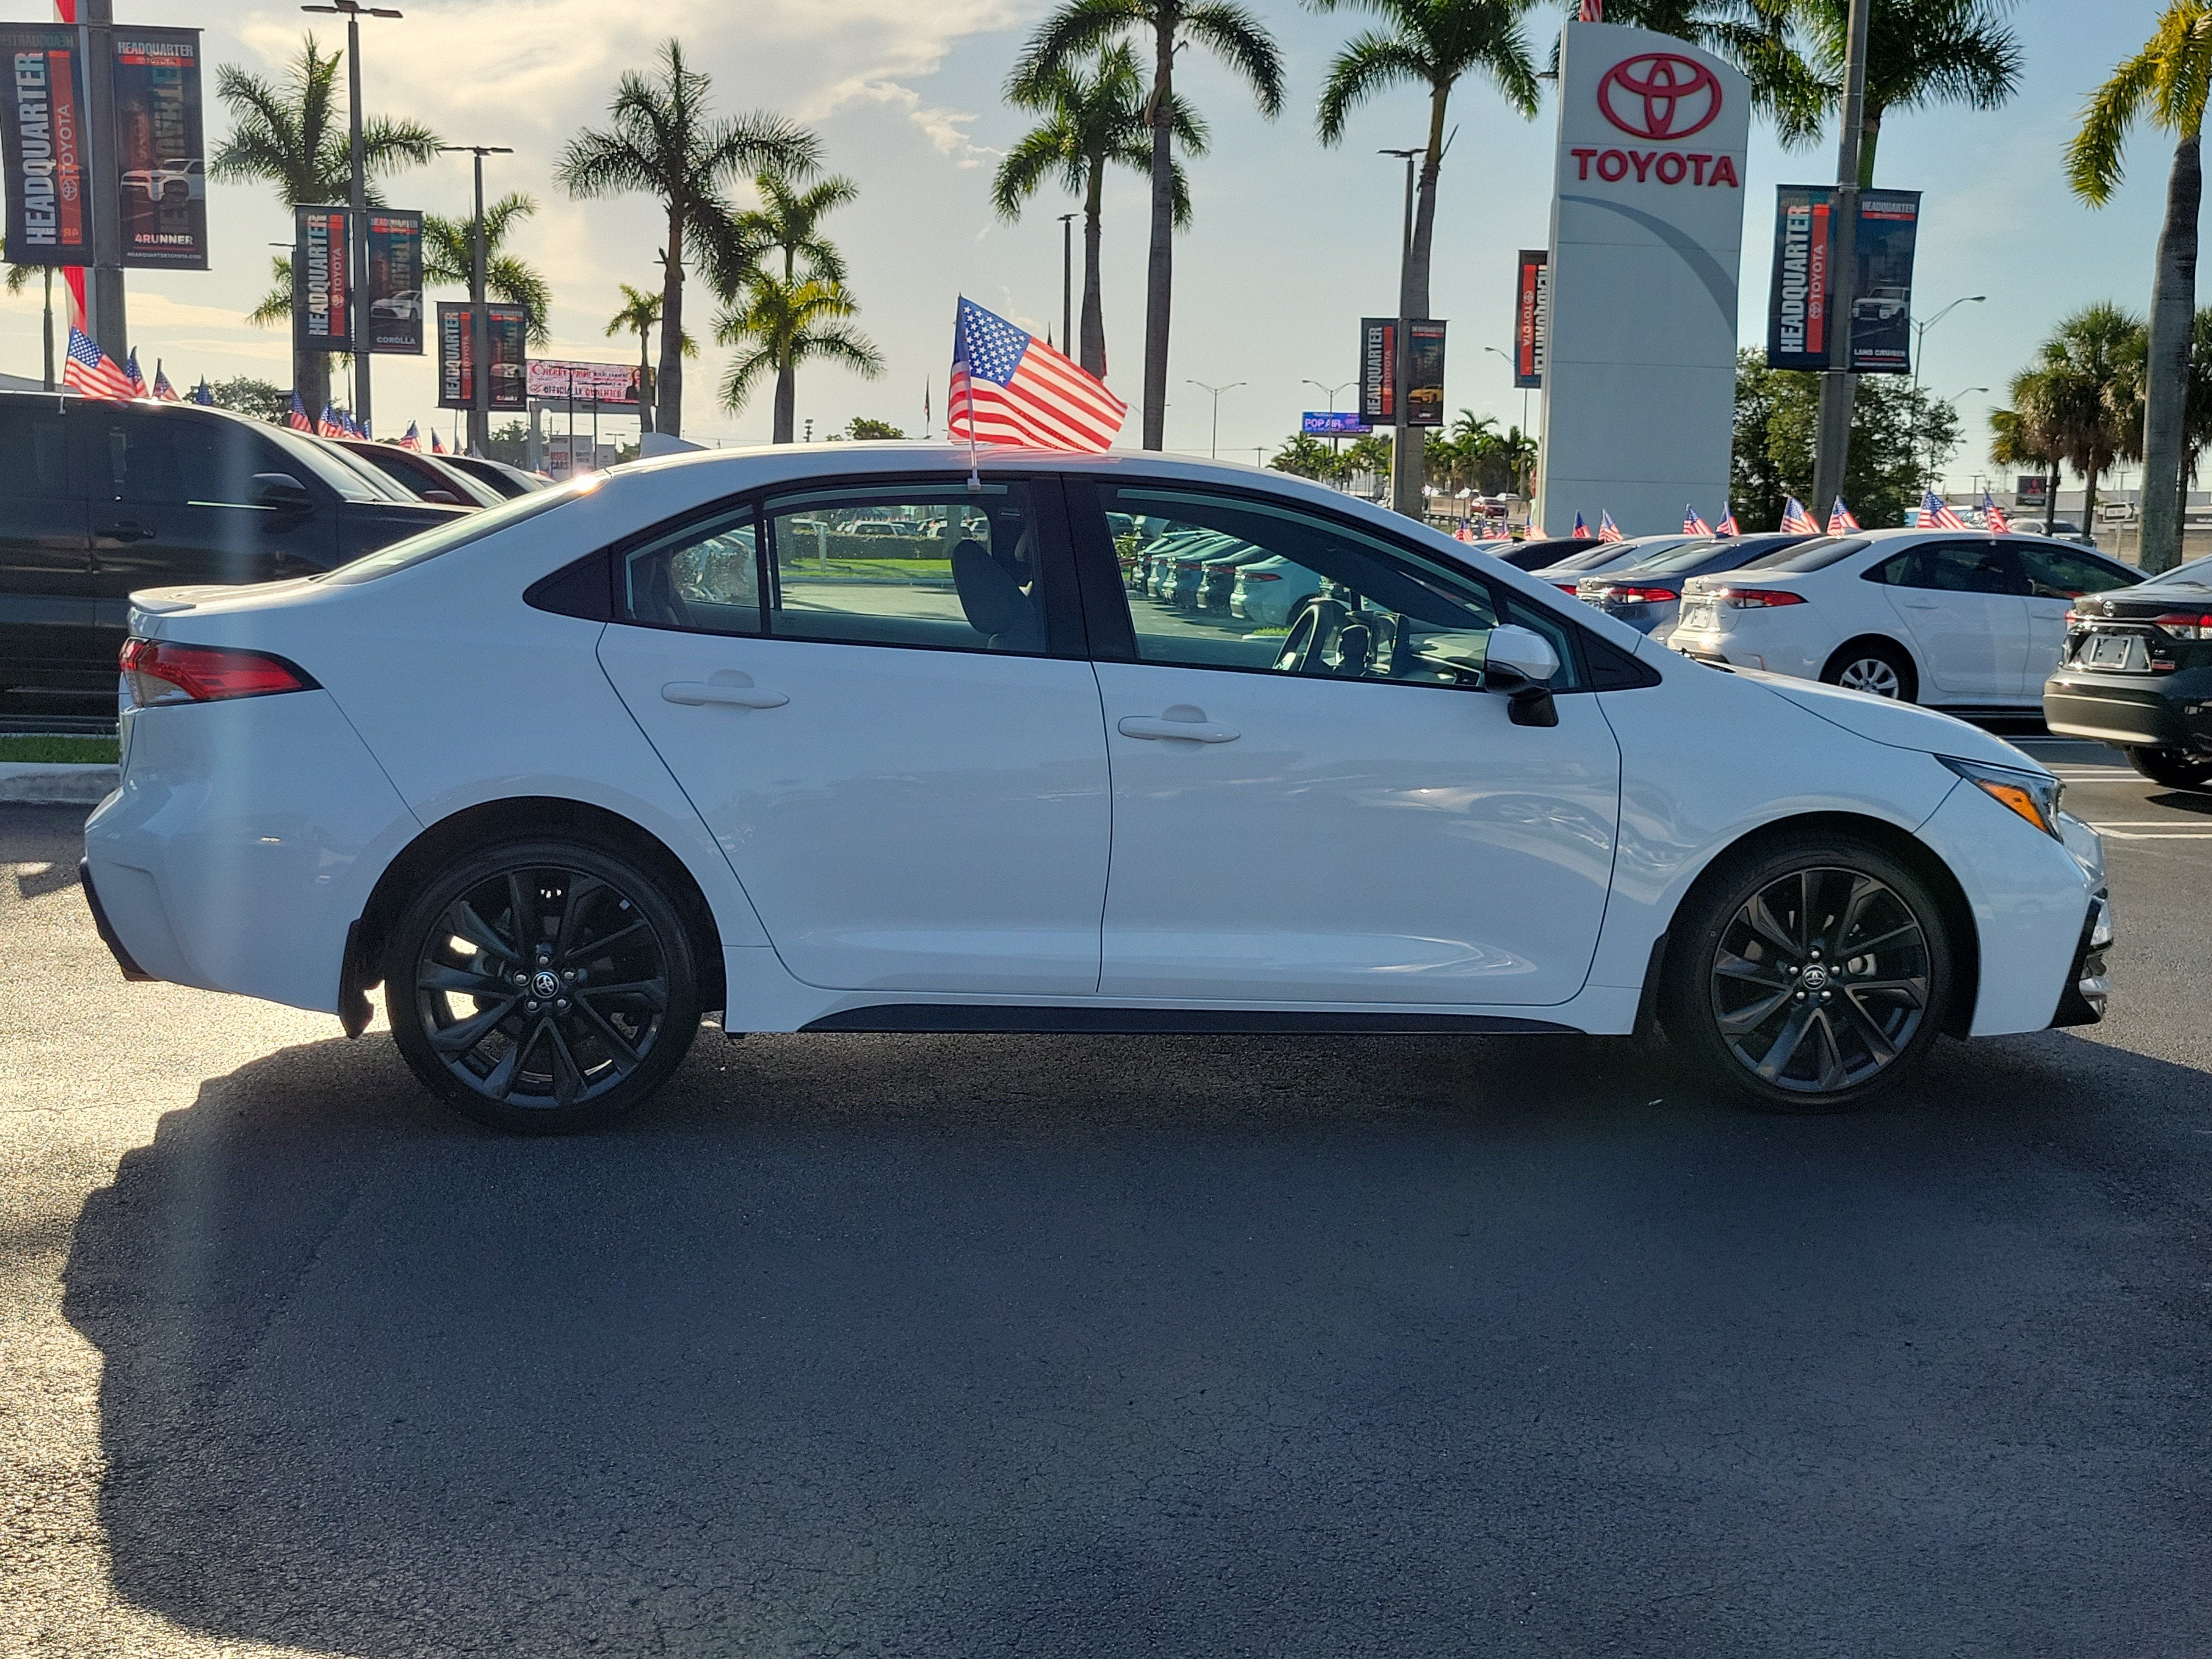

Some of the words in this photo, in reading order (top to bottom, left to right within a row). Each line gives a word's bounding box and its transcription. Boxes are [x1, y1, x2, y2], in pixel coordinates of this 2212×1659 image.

[118, 42, 193, 57] HEADQUARTER
[15, 52, 56, 245] HEADQUARTER
[58, 104, 74, 176] TOYOTA
[1571, 149, 1739, 188] TOYOTA
[134, 233, 194, 245] 4RUNNER
[308, 215, 330, 336] HEADQUARTER
[333, 249, 342, 292] TOYOTA
[1780, 205, 1810, 353] HEADQUARTER
[1811, 244, 1825, 303] TOYOTA
[376, 336, 416, 345] COROLLA
[1523, 305, 1533, 346] TOYOTA
[445, 312, 461, 399] HEADQUARTER
[1367, 327, 1383, 415] HEADQUARTER
[1305, 418, 1325, 427] POP
